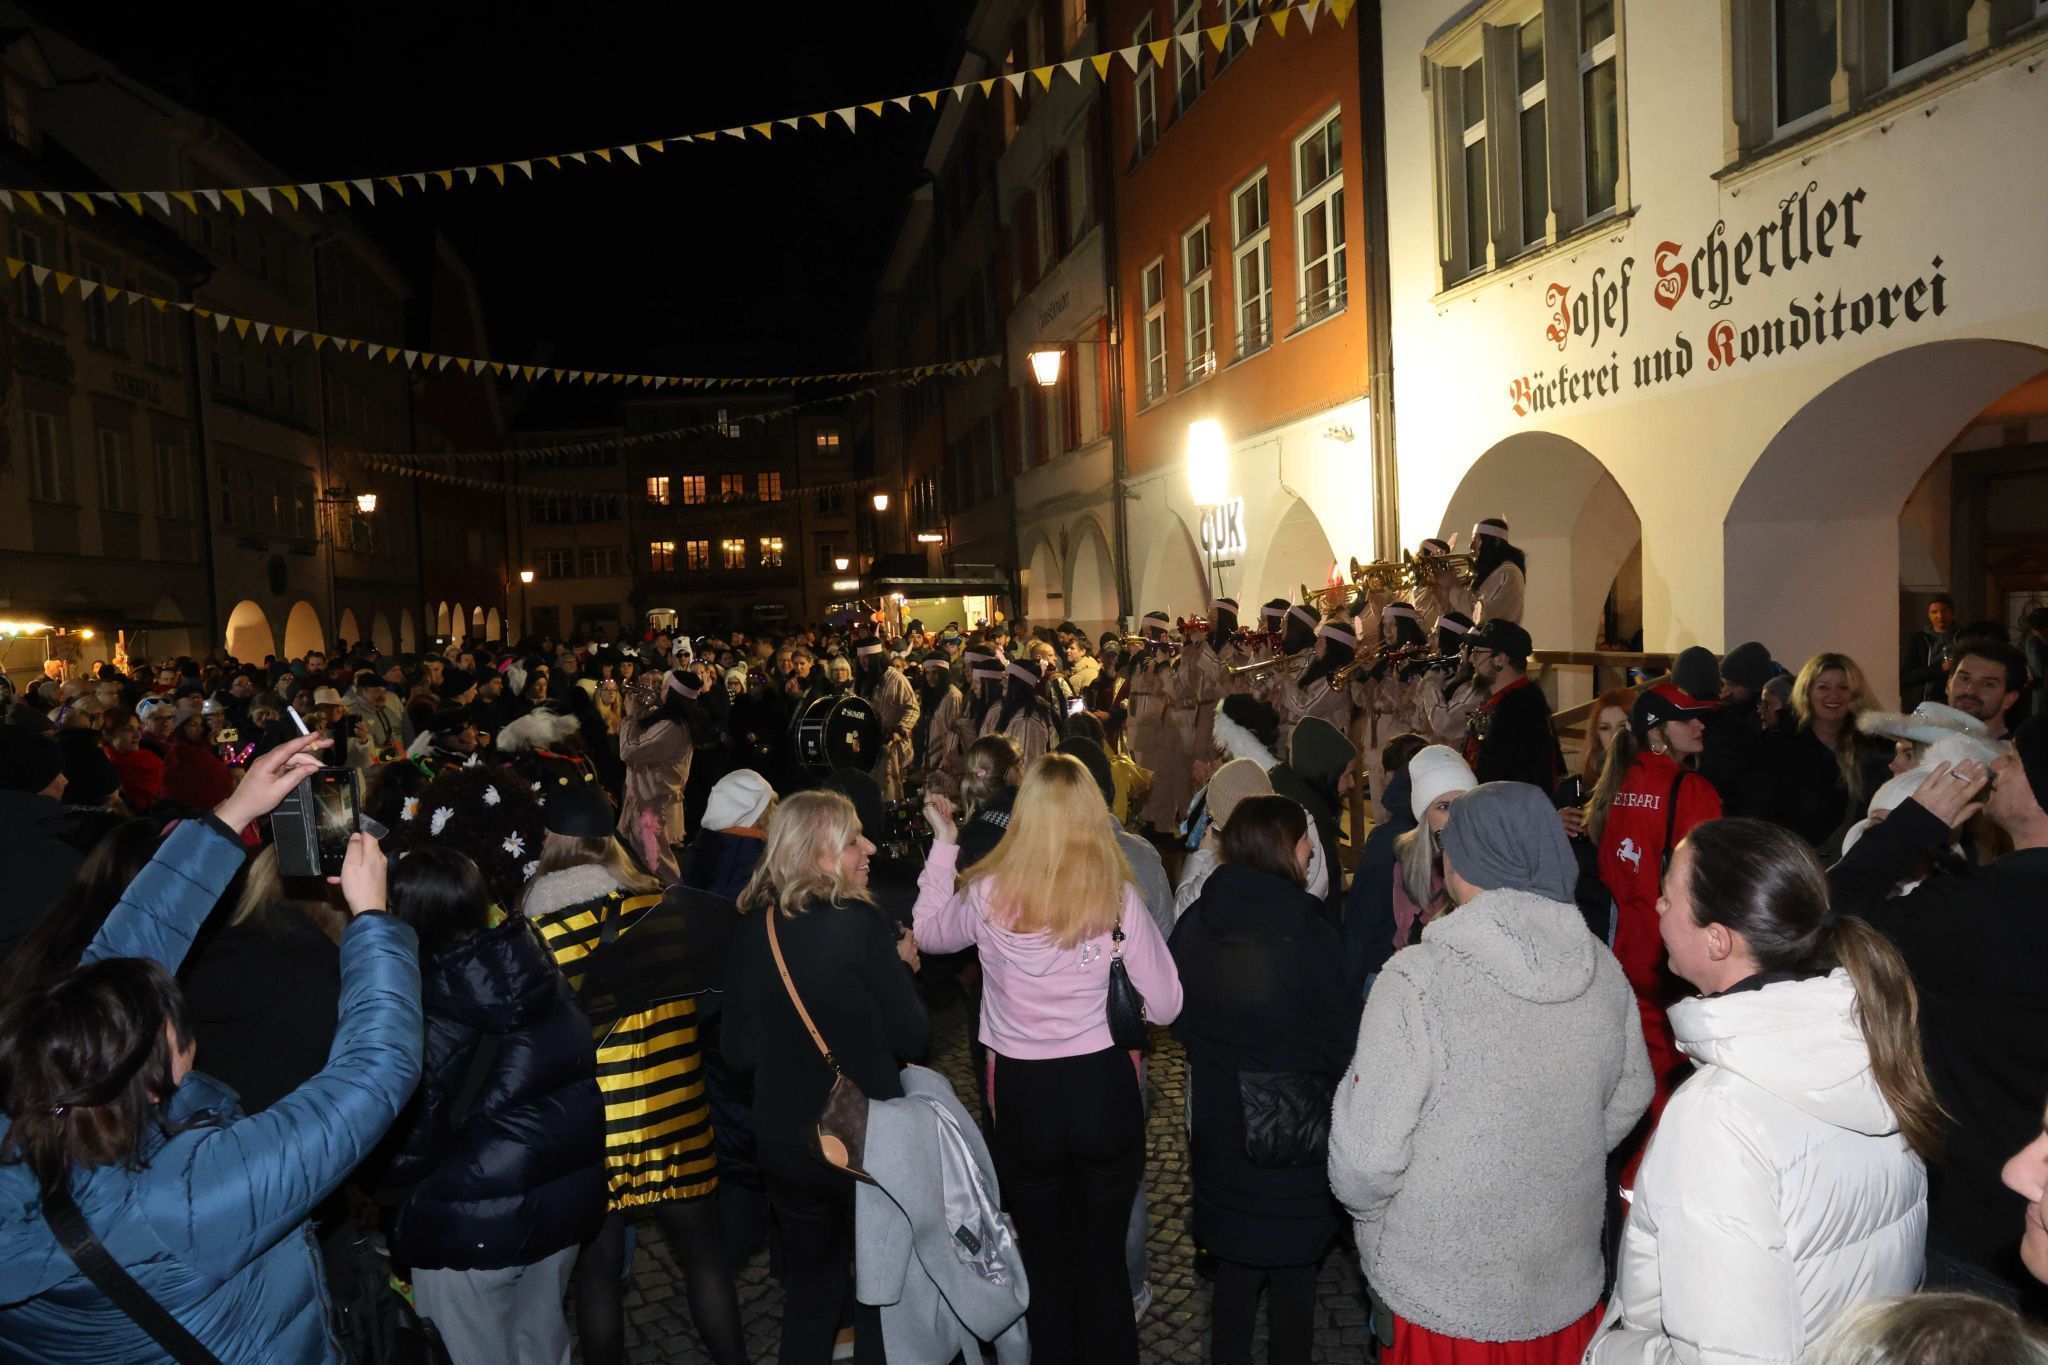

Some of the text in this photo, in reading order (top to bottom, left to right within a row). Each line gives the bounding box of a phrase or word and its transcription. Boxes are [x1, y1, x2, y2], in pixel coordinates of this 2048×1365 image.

[1509, 254, 1949, 417] Bäckerei und Konditorei
[1546, 256, 1636, 352] Josef
